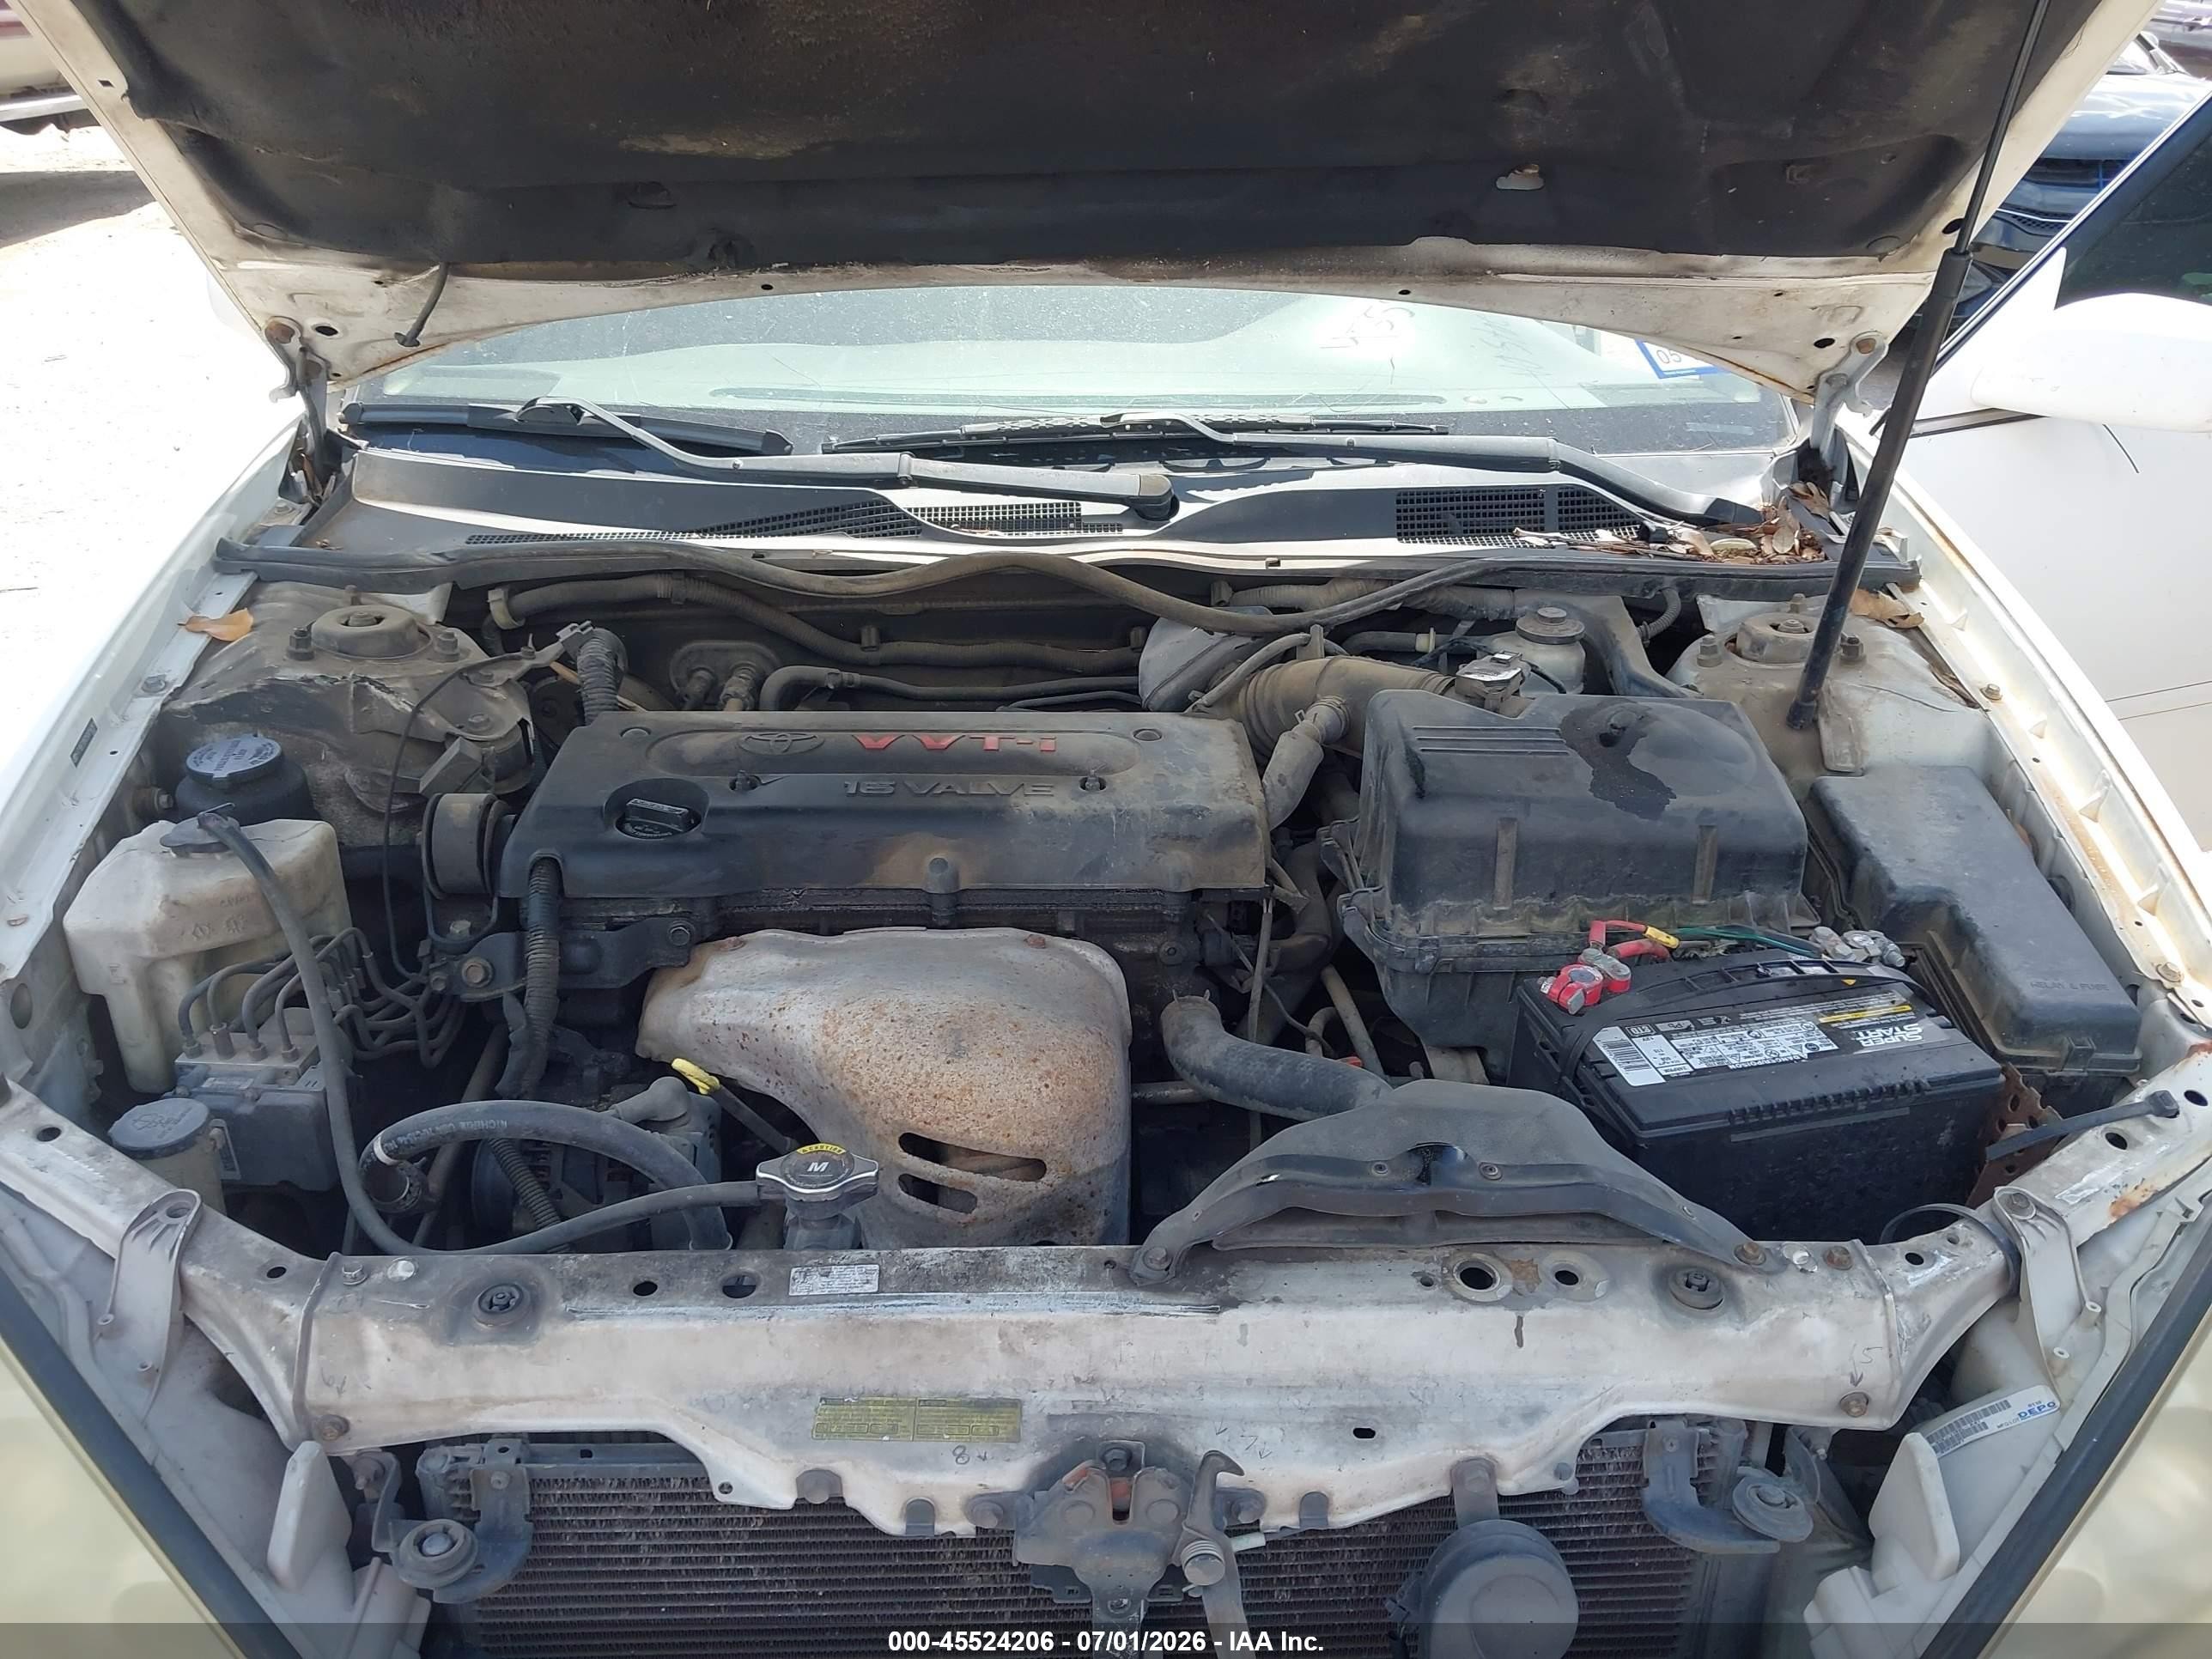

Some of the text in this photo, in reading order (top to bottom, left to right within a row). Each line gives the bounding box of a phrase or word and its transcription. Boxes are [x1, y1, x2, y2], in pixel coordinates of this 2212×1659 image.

[844, 781, 1055, 797] 16 VALVE
[1856, 1024, 1923, 1041] START
[1859, 1033, 1923, 1047] SUPER
[2017, 1401, 2057, 1419] DEPO
